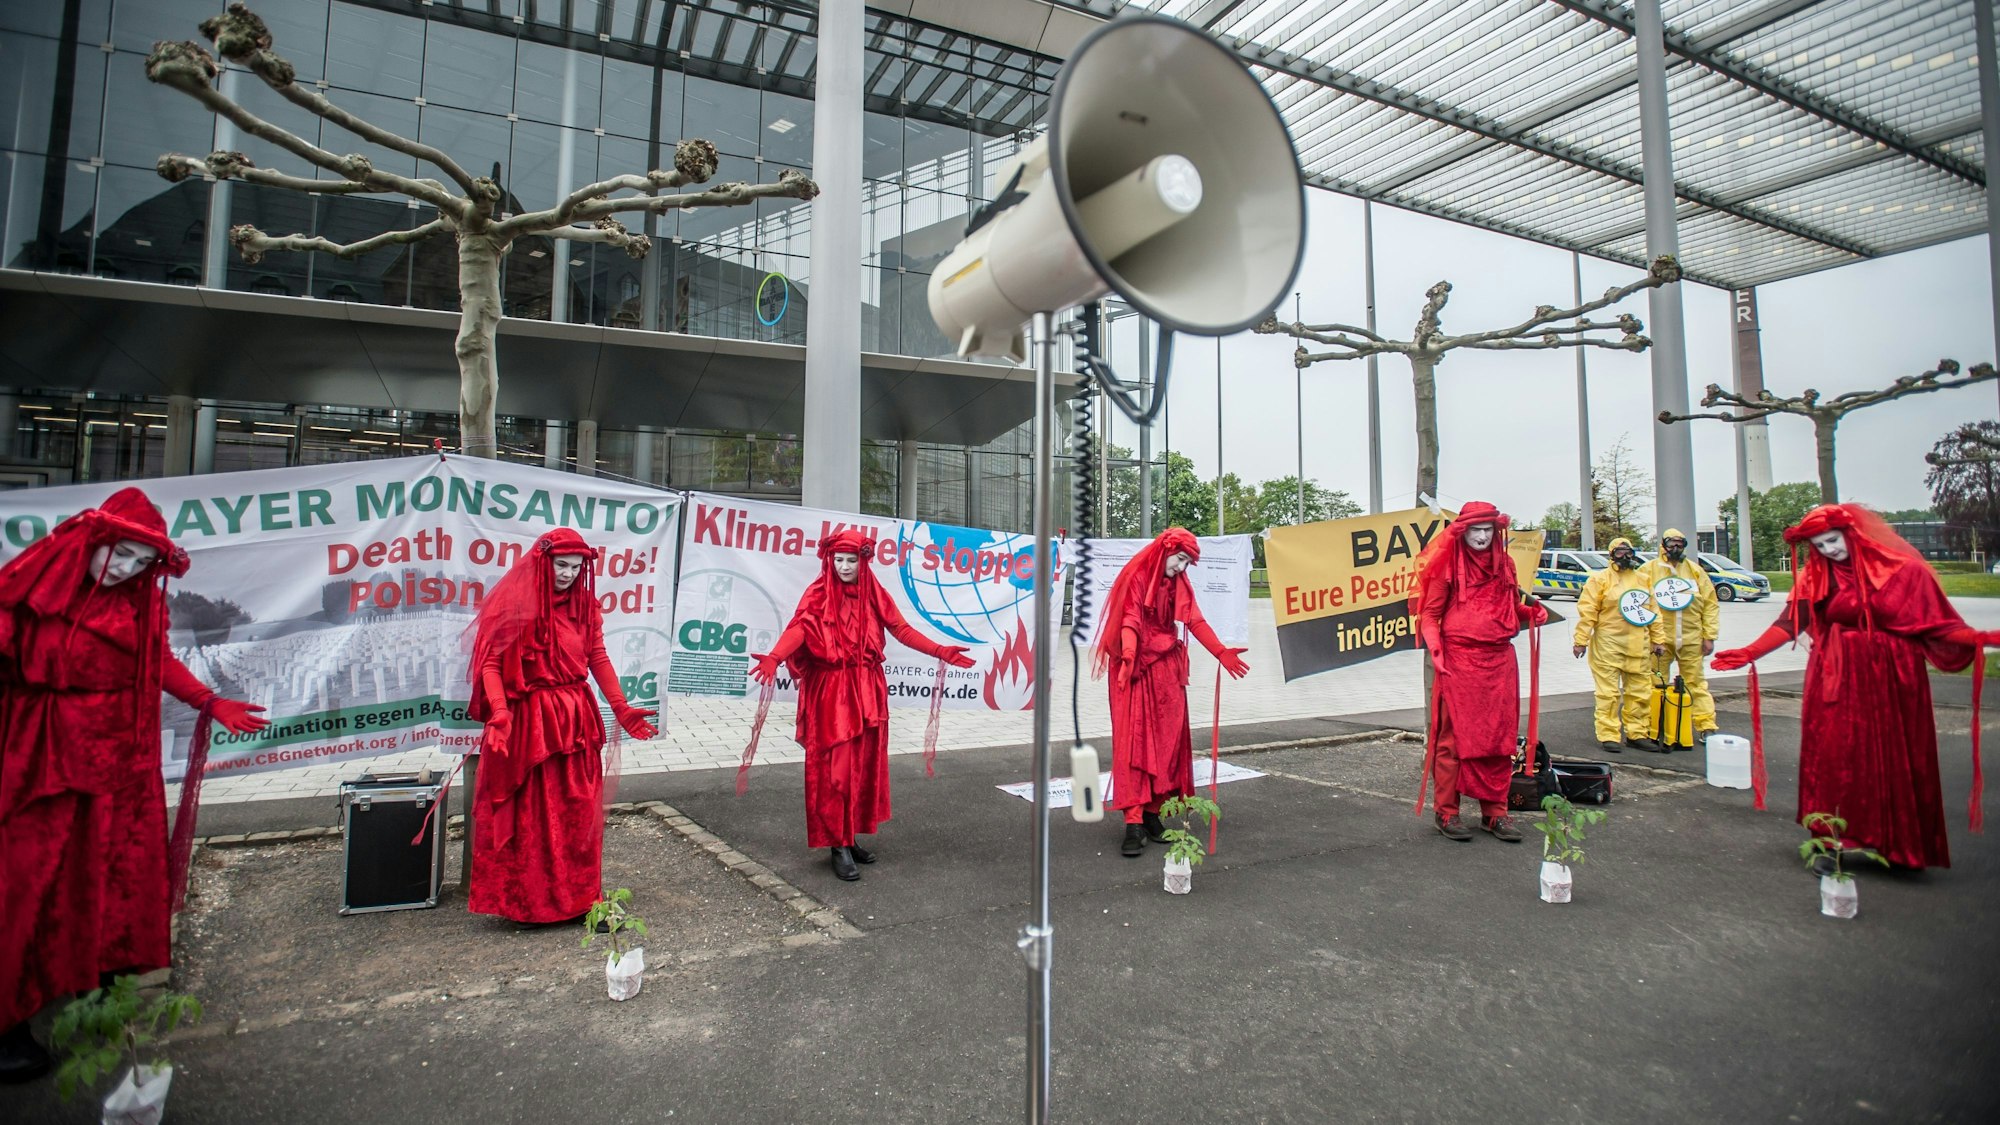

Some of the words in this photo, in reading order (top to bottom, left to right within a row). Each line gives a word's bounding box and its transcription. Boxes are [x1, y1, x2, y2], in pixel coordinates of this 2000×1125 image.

[154, 489, 336, 538] AYER
[327, 527, 452, 576] Death
[595, 546, 658, 578] lds!
[922, 537, 1061, 584] stoppe!
[1351, 519, 1452, 568] BAY
[1285, 586, 1343, 616] Eure
[1350, 562, 1425, 604] Pestizi
[678, 619, 748, 654] CBG
[599, 671, 658, 705] BG
[884, 665, 980, 680] BAYER-Gefahren
[213, 716, 347, 746] Coordination
[354, 706, 414, 730] gegen
[203, 735, 397, 773] www.CBGnetwork.org
